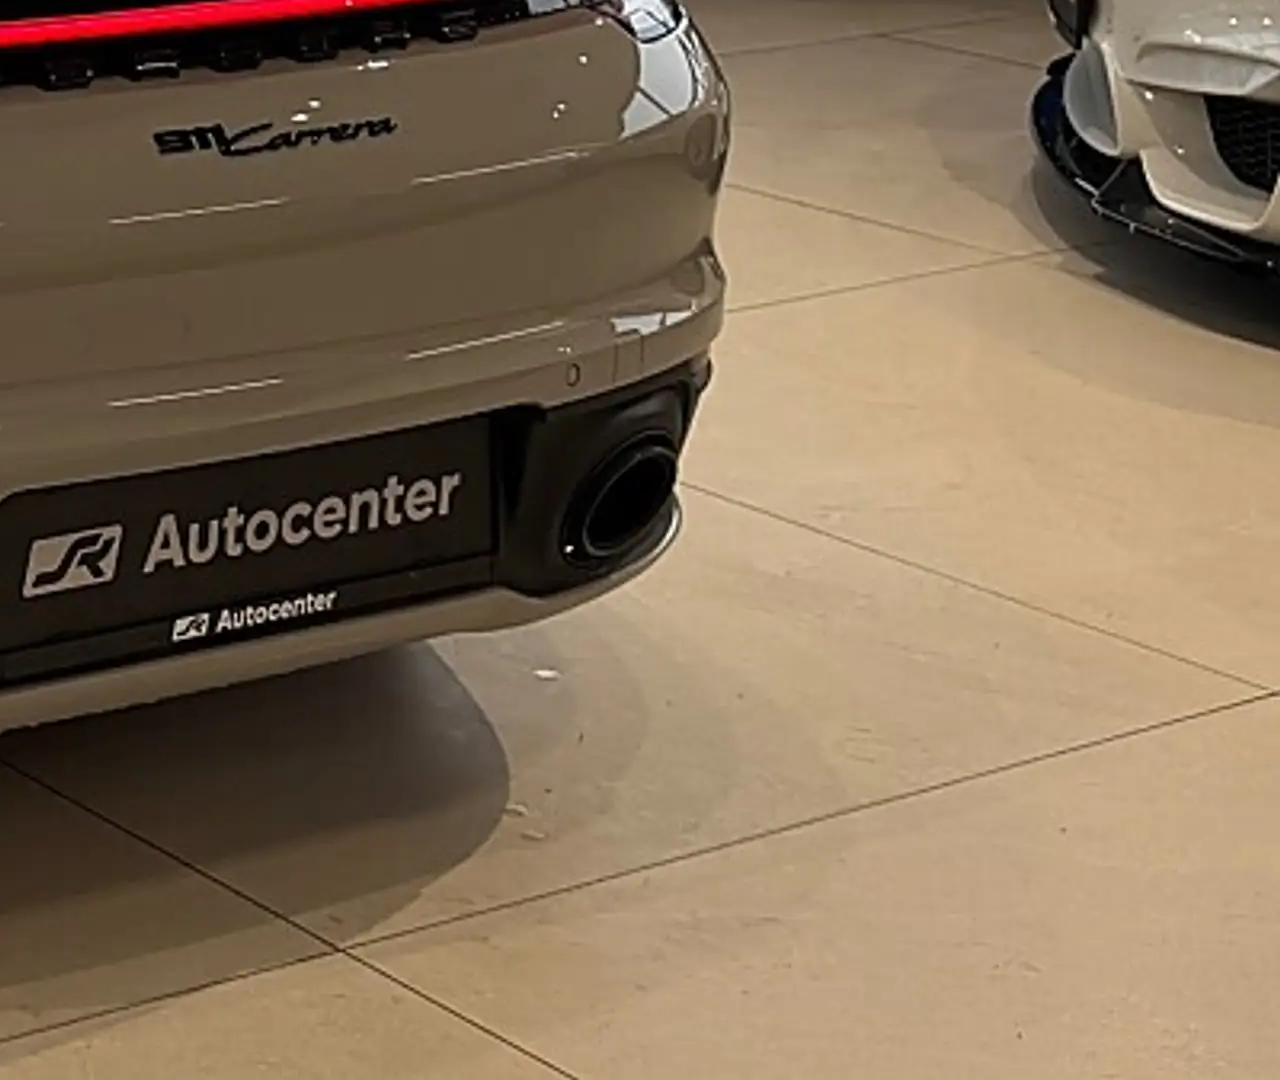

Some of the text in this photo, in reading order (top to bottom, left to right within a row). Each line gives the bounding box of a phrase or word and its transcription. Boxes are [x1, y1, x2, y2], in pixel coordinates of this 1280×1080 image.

[153, 117, 398, 157] 911 Carrera
[143, 472, 463, 574] Autocenter
[216, 591, 338, 634] Autocenter
